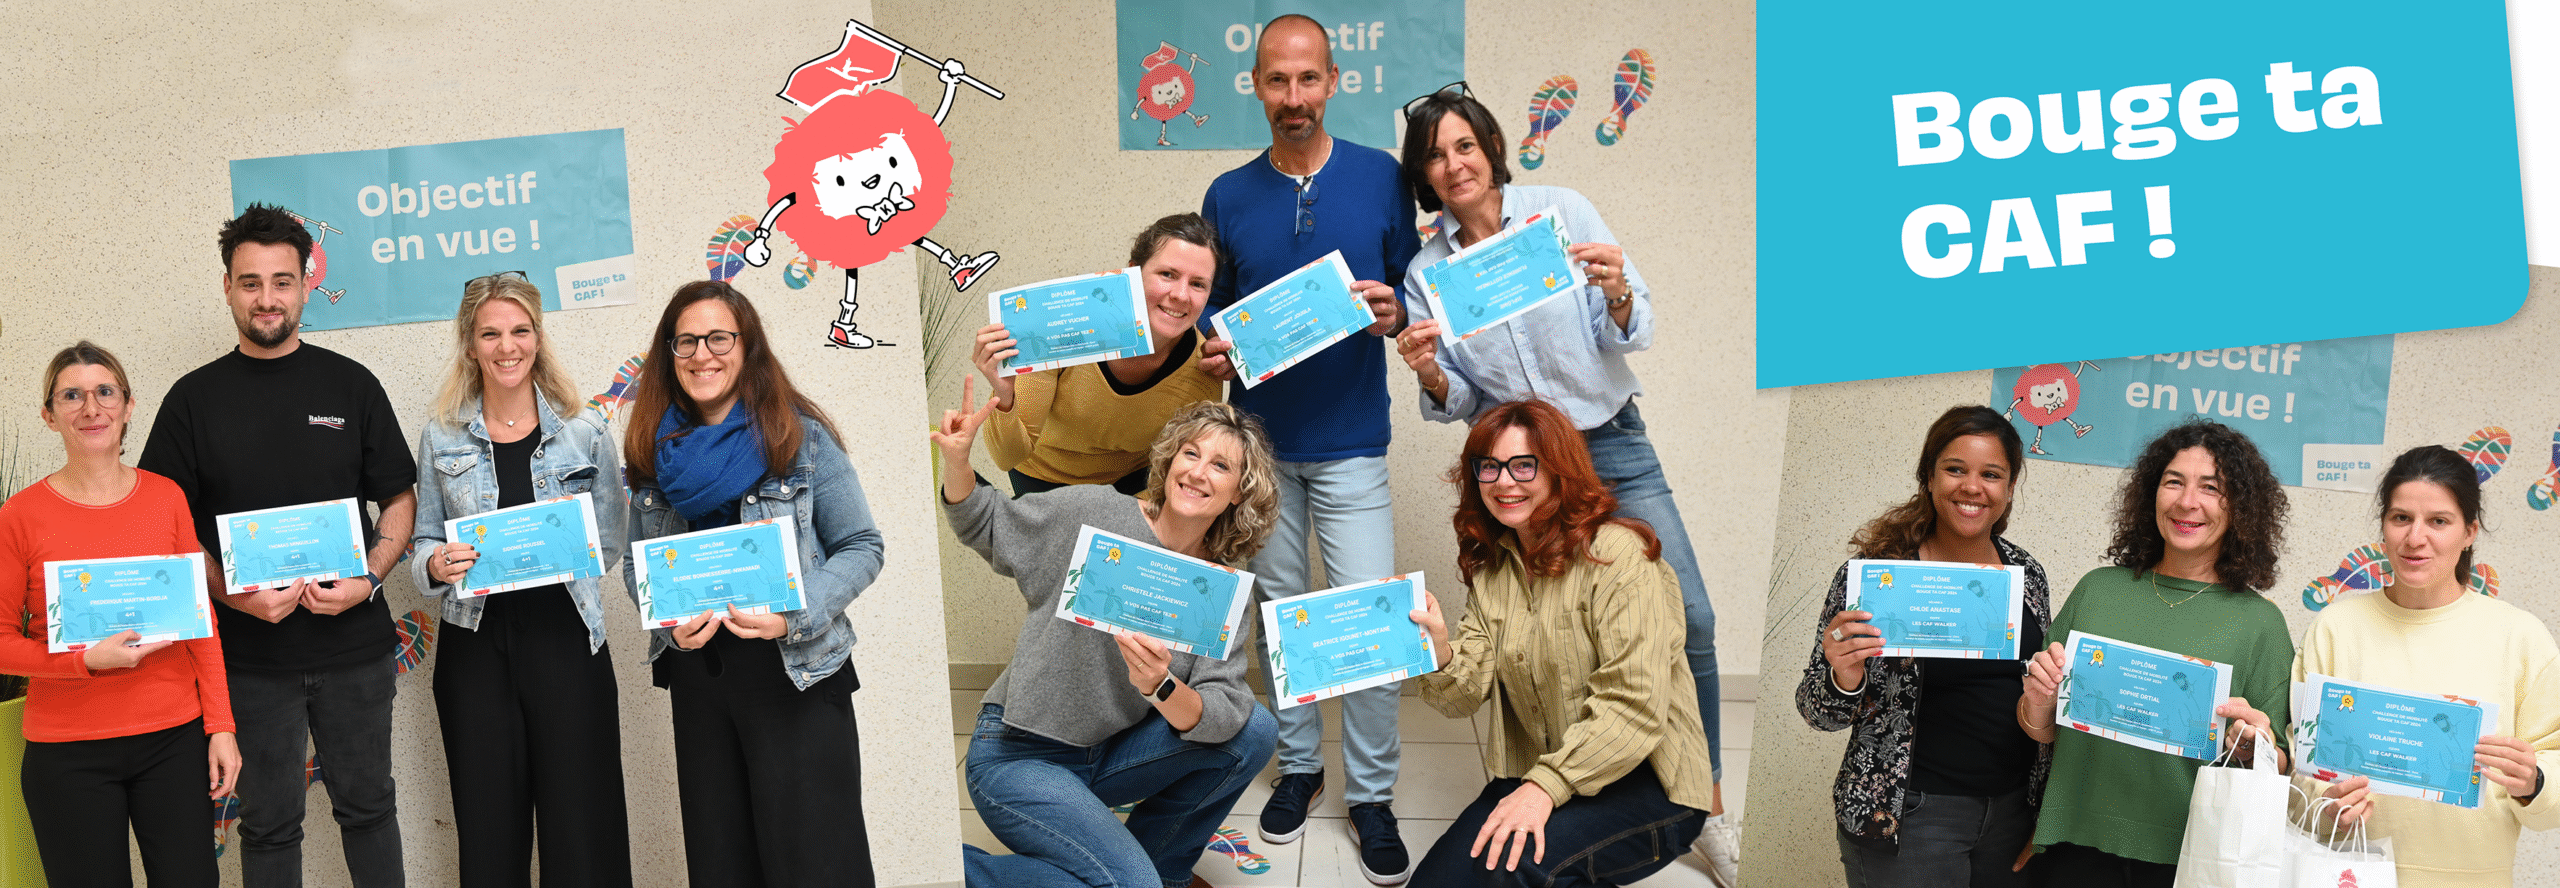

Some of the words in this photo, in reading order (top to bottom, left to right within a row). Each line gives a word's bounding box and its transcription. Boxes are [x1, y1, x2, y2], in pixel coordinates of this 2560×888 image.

[1225, 21, 1384, 52] Octif
[357, 171, 537, 218] Objectif
[372, 235, 424, 263] en
[436, 227, 516, 258] vue
[530, 219, 540, 250] !
[573, 277, 610, 289] Bouge
[613, 274, 626, 282] ta
[574, 290, 598, 301] CAF
[2127, 343, 2302, 376] jectif
[2126, 382, 2178, 411] en
[2192, 387, 2271, 420] vue
[2284, 393, 2295, 423] !
[2317, 460, 2355, 470] Bouge
[2358, 461, 2371, 469] ta
[2317, 472, 2341, 481] CAF
[1150, 561, 1178, 573] DIPLÔME
[1334, 599, 1360, 609] DIPLÔME
[2131, 660, 2158, 670] DIPLÔME
[2119, 689, 2139, 698] SOPHIE
[2137, 708, 2159, 717] WALKER
[2385, 703, 2416, 713] DIPLÔME
[2368, 732, 2398, 743] VIOLAINE
[2398, 738, 2424, 748] TRUCHE
[2392, 753, 2417, 763] WALKER
